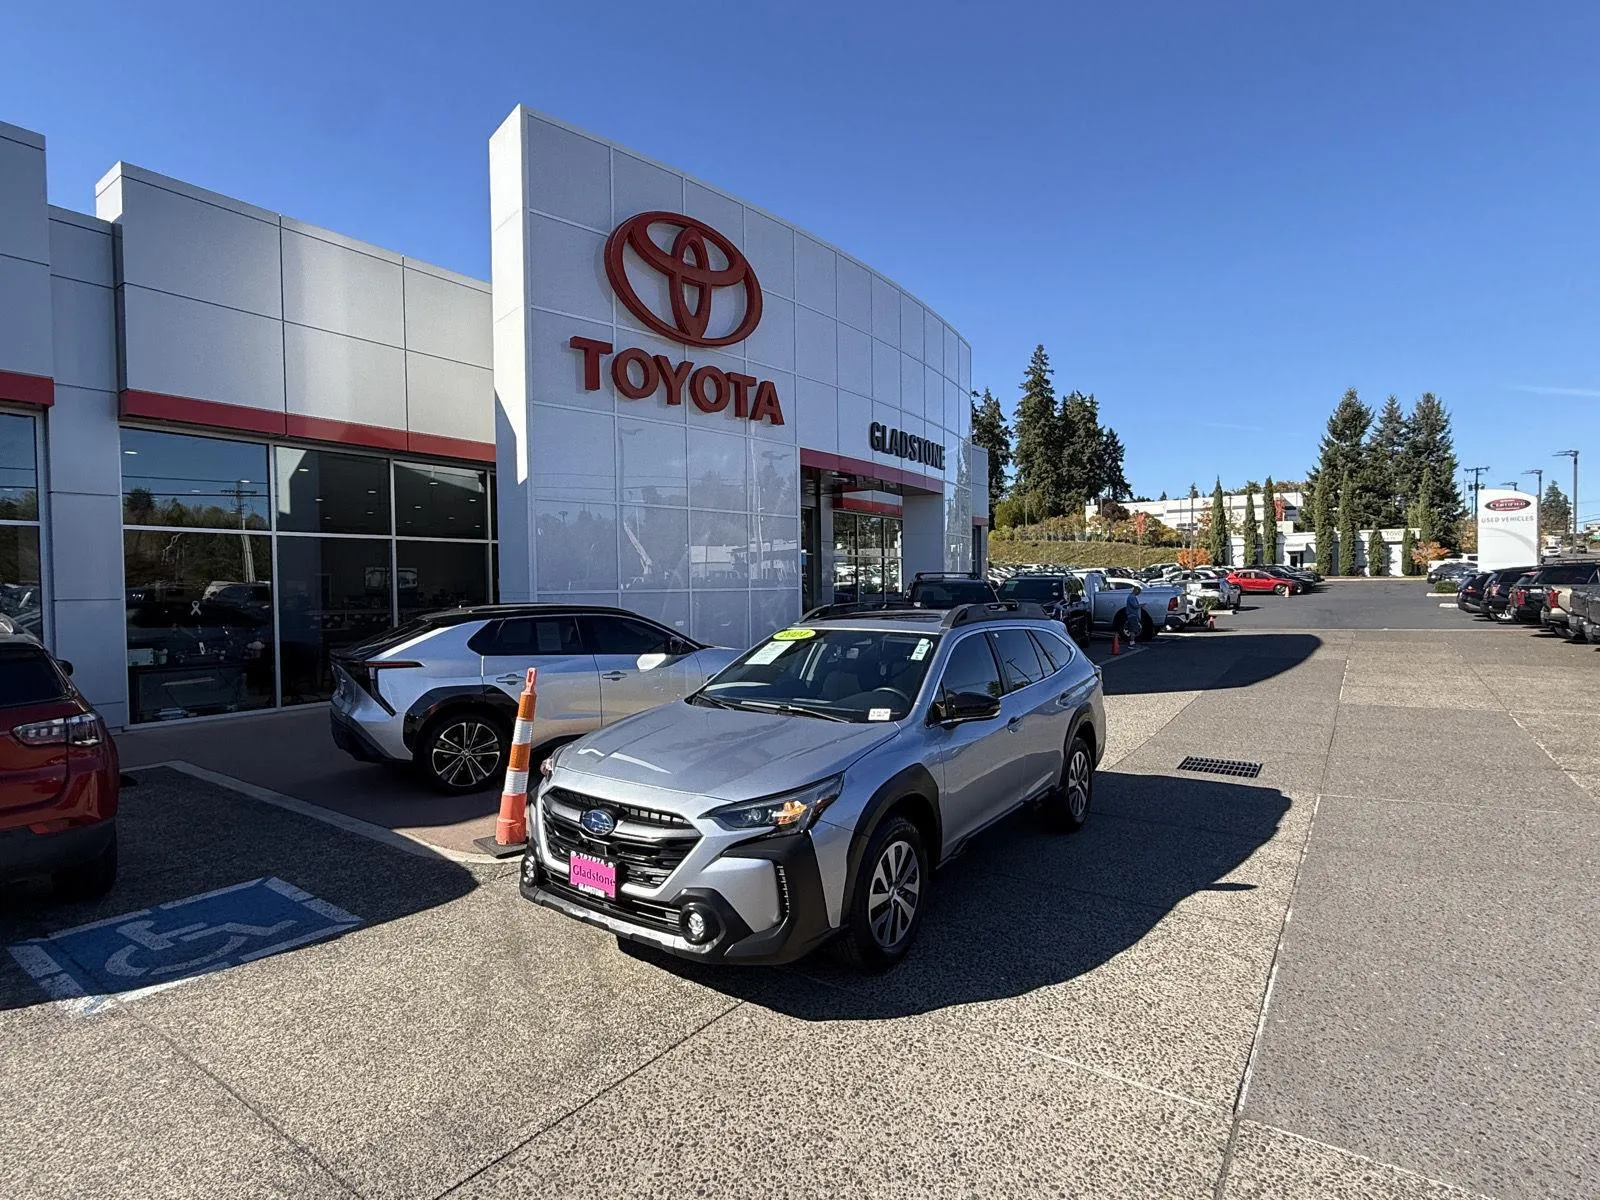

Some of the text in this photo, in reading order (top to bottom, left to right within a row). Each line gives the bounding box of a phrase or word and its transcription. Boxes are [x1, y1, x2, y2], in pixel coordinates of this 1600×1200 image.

[569, 335, 785, 426] TOYOTA
[869, 421, 946, 471] GLADSTONE
[572, 864, 616, 886] Gladstone
